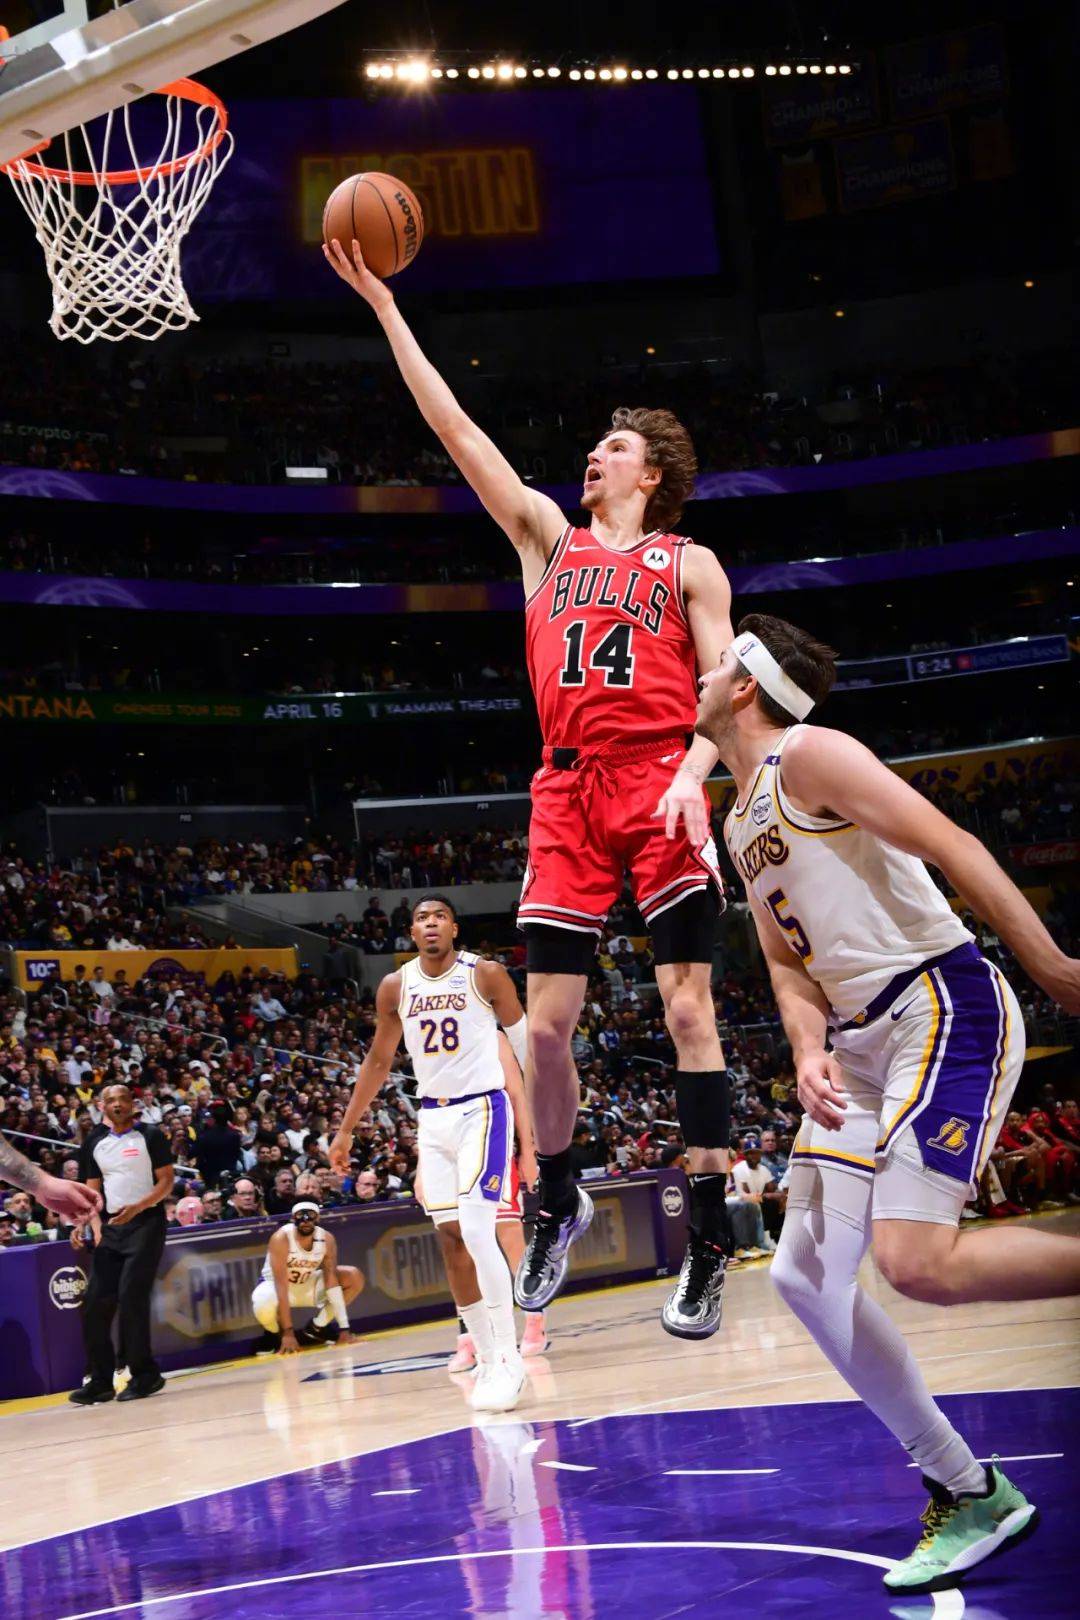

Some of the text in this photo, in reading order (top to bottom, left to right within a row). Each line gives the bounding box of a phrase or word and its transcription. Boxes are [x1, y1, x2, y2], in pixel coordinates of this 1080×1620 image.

[548, 565, 671, 636] BULLS
[559, 619, 636, 689] 14
[263, 703, 317, 719] APRIL
[321, 702, 344, 718] 16
[458, 698, 522, 712] THEATER
[764, 889, 814, 964] 5
[407, 992, 467, 1018] LAKERS
[419, 1017, 460, 1056] 28
[53, 1277, 86, 1295] bibigo
